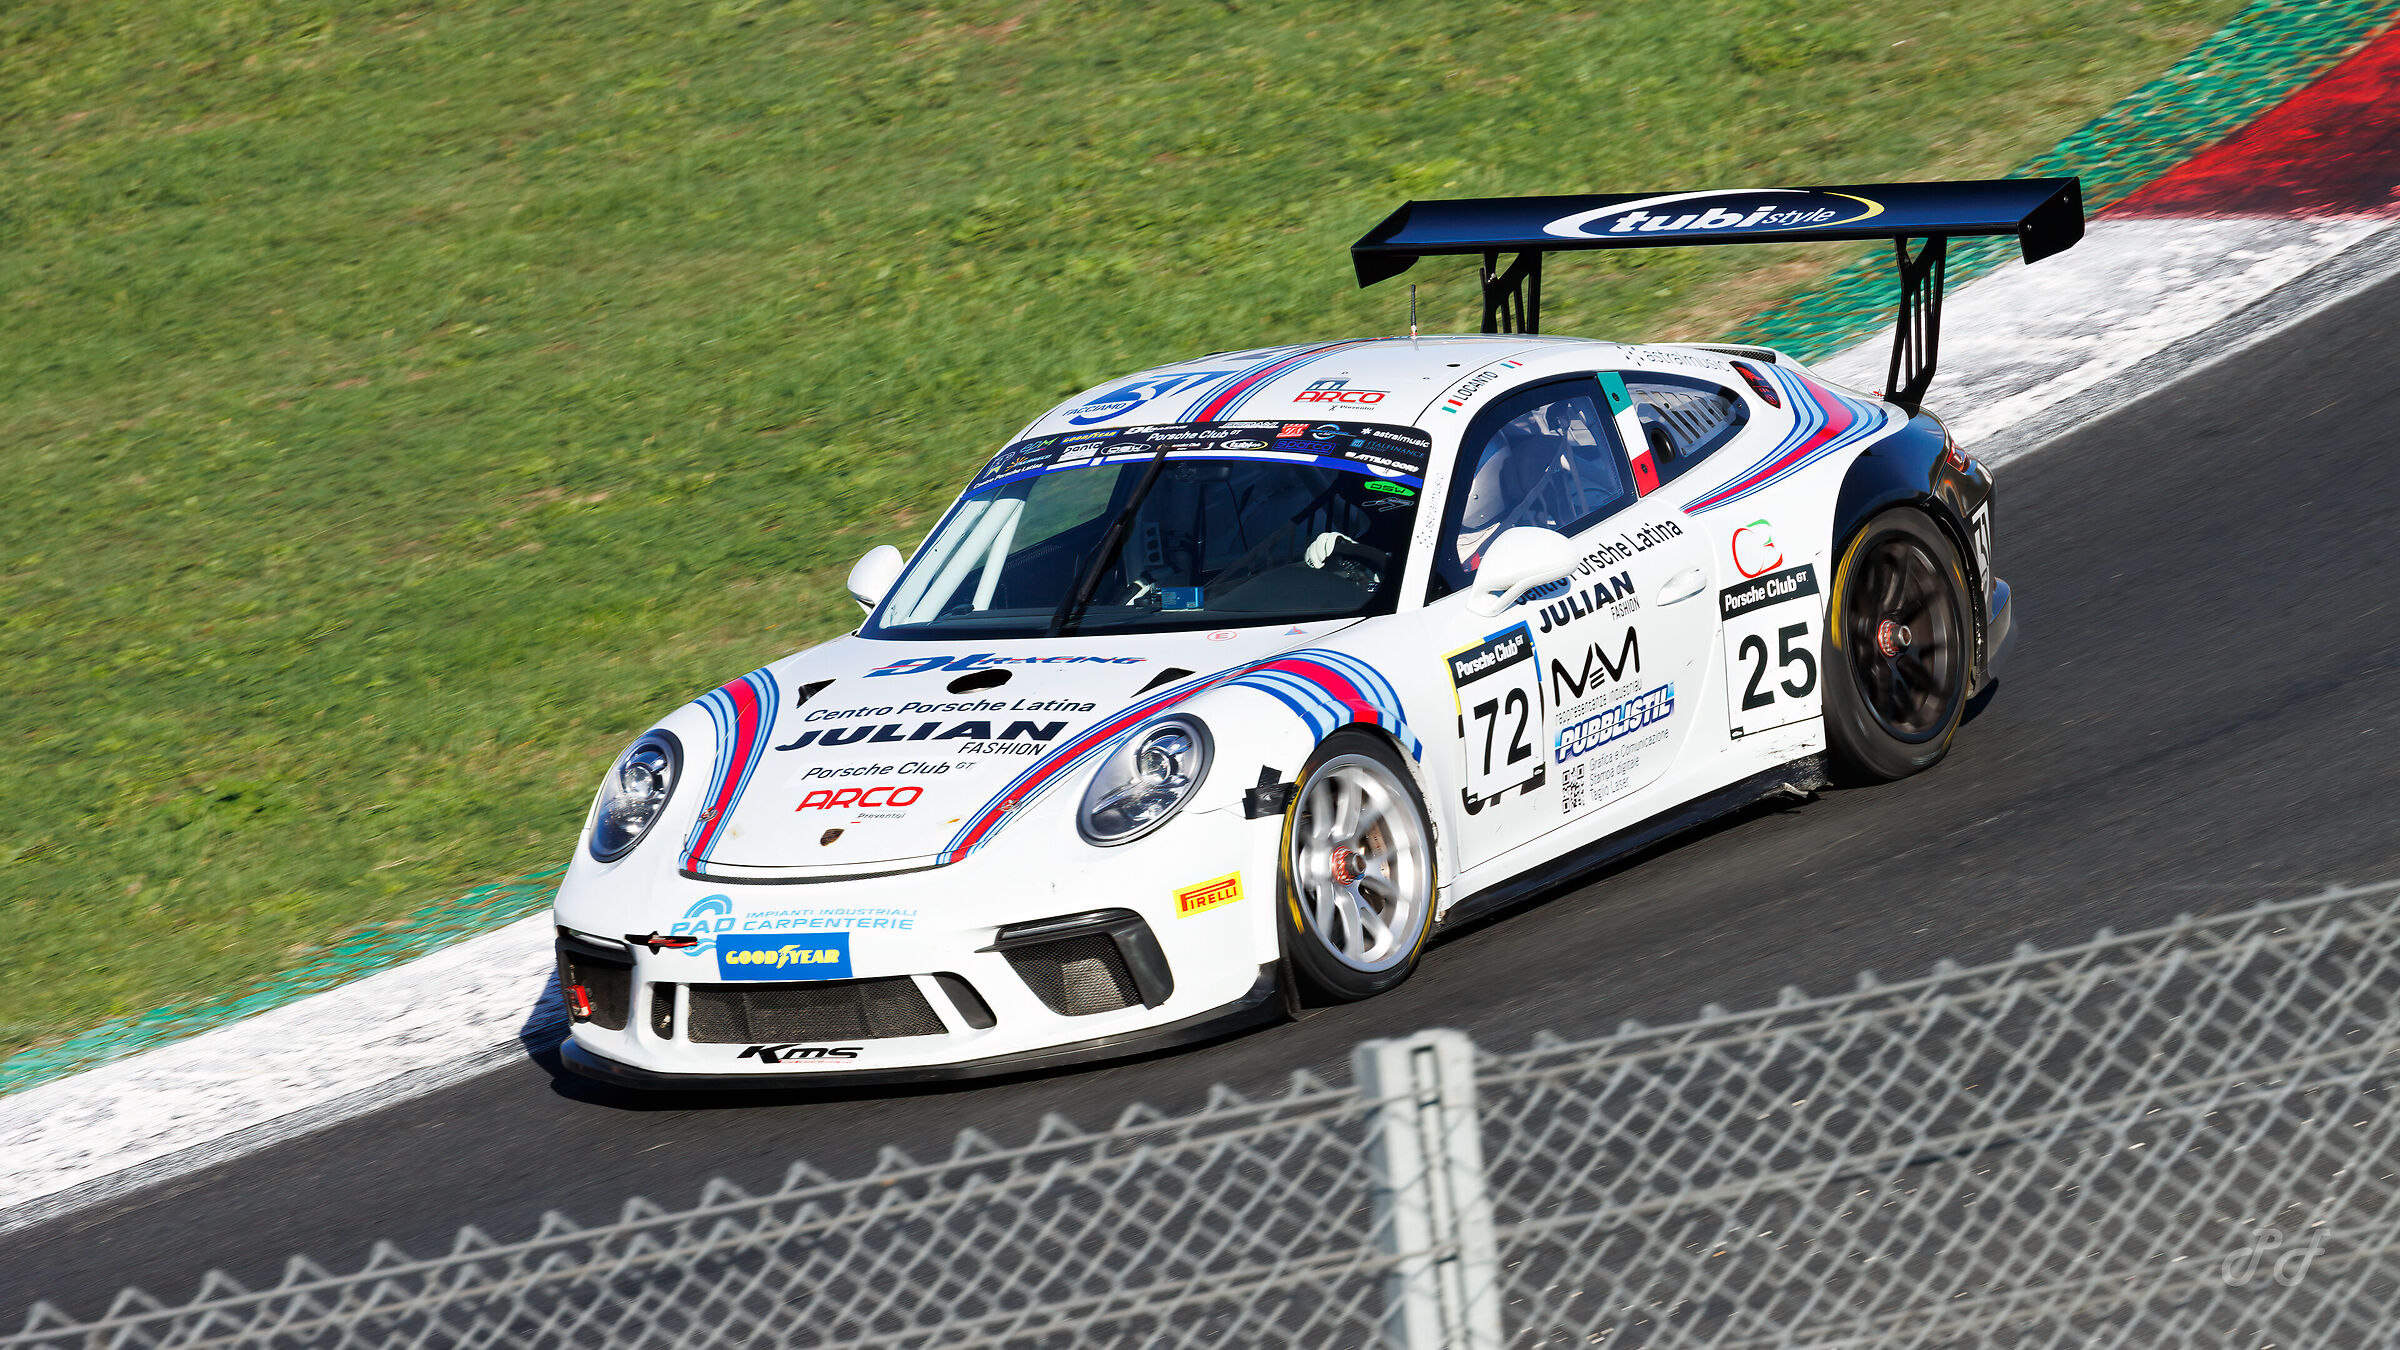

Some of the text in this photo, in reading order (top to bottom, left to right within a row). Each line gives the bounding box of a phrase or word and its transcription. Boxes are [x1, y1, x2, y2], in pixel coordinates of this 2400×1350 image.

[1609, 205, 1836, 233] tubi style
[1644, 350, 1731, 372] astralmusic
[1292, 391, 1386, 403] ARCO
[1453, 371, 1499, 401] LOCANTO
[1061, 402, 1127, 417] FACCIAMO
[1146, 431, 1198, 441] Porsche
[1199, 429, 1229, 439] Club
[1277, 439, 1331, 451] sparco
[1373, 429, 1430, 448] astralmusic
[1570, 543, 1633, 581] orsche
[1621, 520, 1683, 552] Latina
[1539, 570, 1636, 634] JULIAN
[1725, 571, 1808, 611] Porsche Club GT
[1610, 596, 1641, 621] FASHION
[977, 655, 1147, 665] RACING
[1455, 651, 1497, 679] Porsche
[1494, 639, 1519, 662] Club
[1738, 621, 1817, 712] 25
[804, 698, 1097, 722] Centro Porsche Latina
[1473, 687, 1532, 776] 72
[1557, 683, 1674, 764] PUBBLISTIL
[775, 720, 1068, 752] JULIAN
[957, 741, 1047, 756] FASHION
[1589, 750, 1614, 772] Grafica
[1620, 728, 1670, 758] Comunicazione
[801, 761, 976, 781] Porsche Club GT
[1589, 766, 1615, 787] Stampa
[1610, 776, 1630, 793] Laser
[795, 786, 924, 812] ARCO
[1180, 878, 1237, 912] PIRELLI
[743, 917, 915, 931] CARPENTERIE
[746, 908, 917, 919] IMPIANTI INDUSTRIALI
[670, 917, 736, 935] PAD
[725, 944, 840, 969] GOODYEAR
